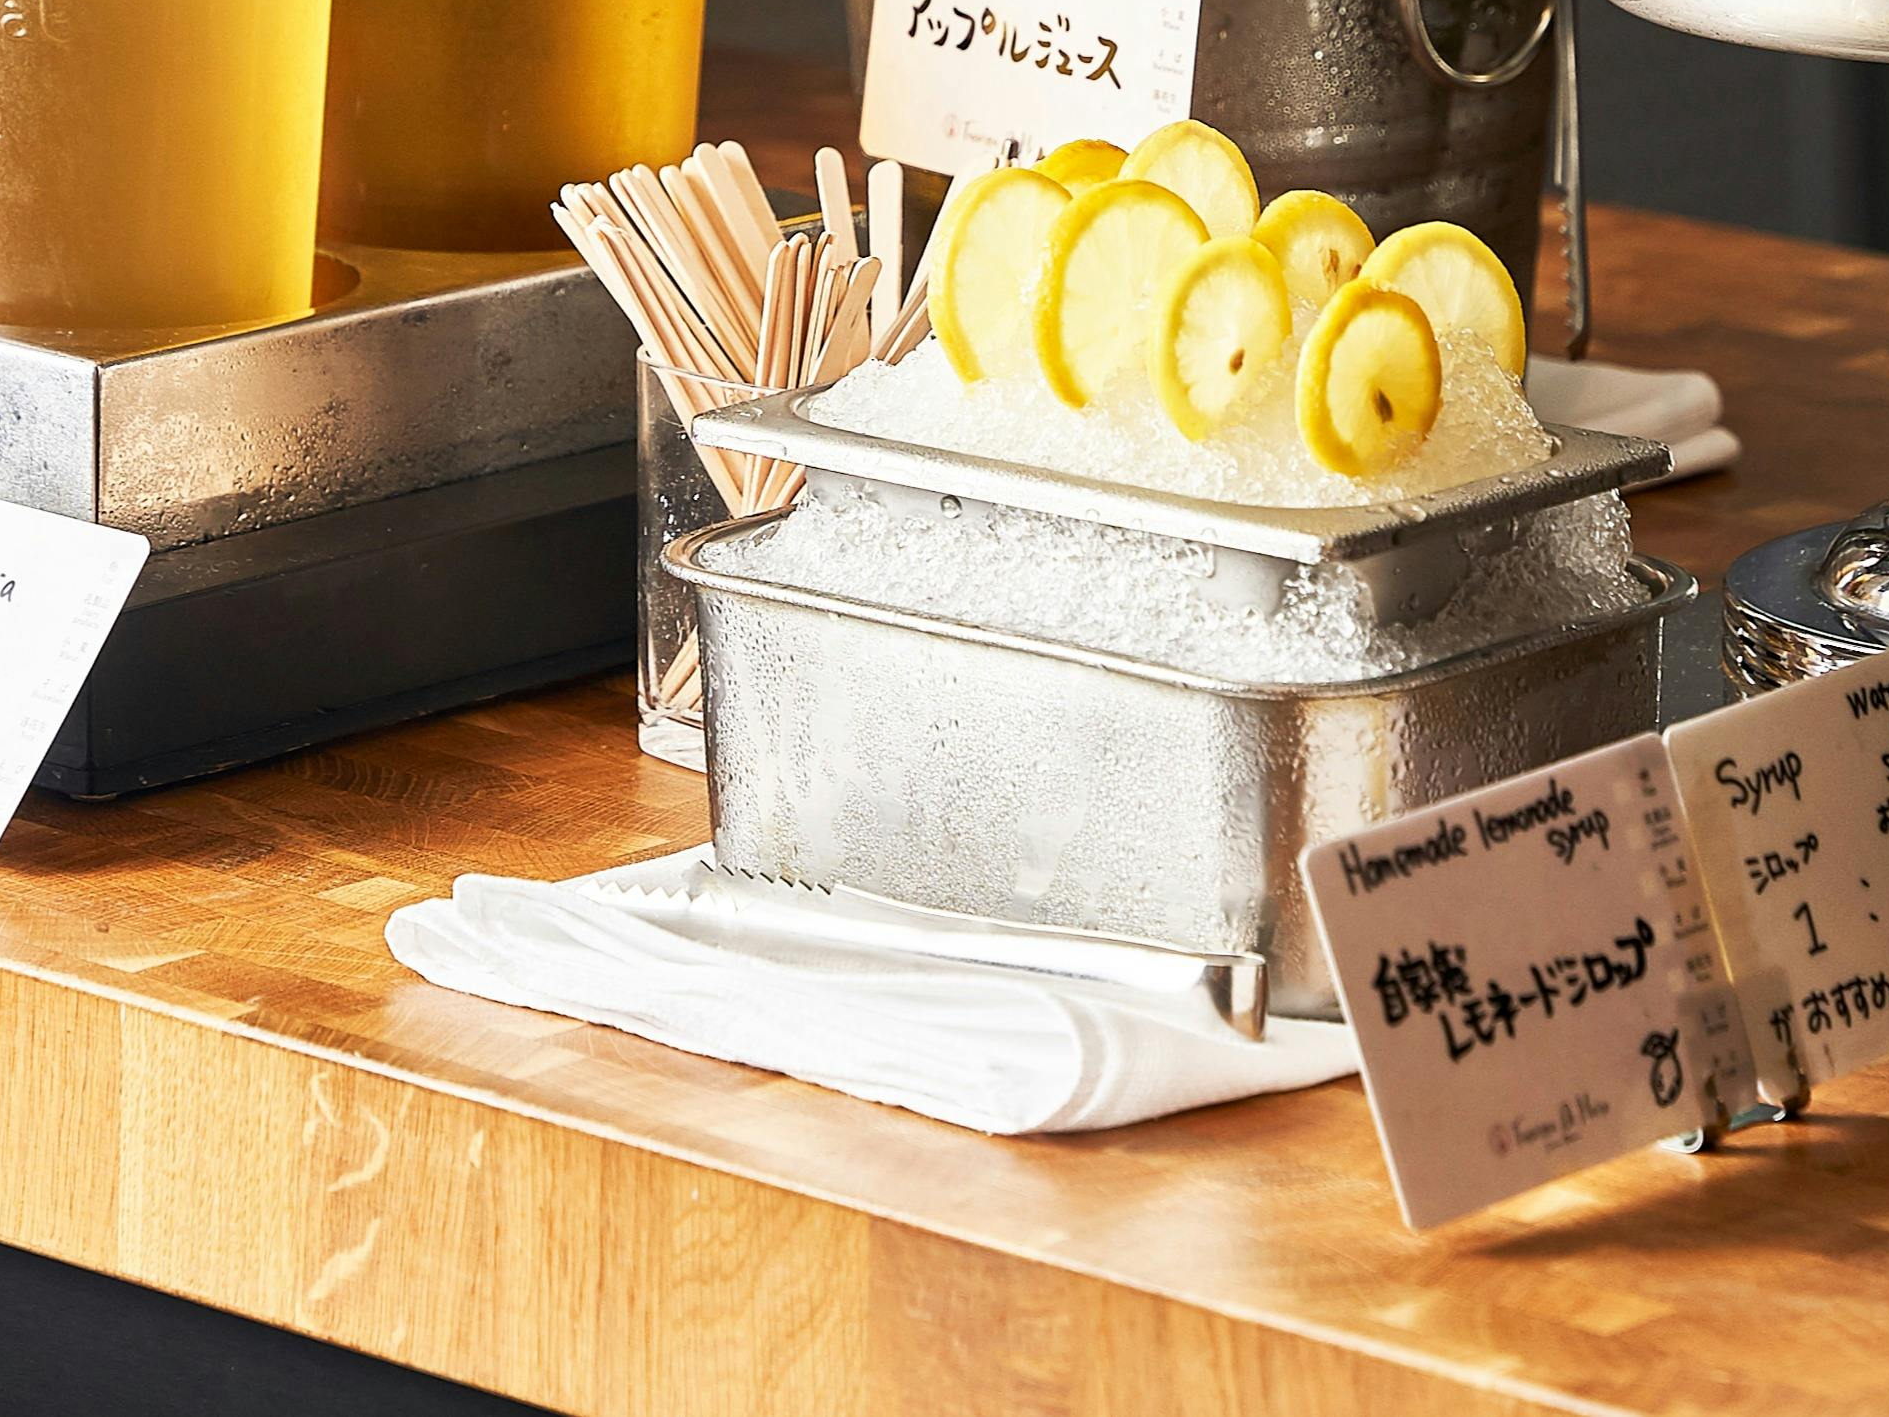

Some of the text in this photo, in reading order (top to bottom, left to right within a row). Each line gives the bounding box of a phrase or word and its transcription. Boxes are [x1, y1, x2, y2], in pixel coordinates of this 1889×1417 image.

[1715, 751, 1803, 815] Syrup
[1338, 818, 1468, 896] Homemade
[1473, 774, 1577, 851] lemonade
[1546, 806, 1611, 866] syrup
[1744, 832, 1820, 895] シロップ
[1793, 901, 1829, 957] 1
[1371, 940, 1473, 1027] 自家製
[1438, 915, 1656, 1062] レモネードシロップ
